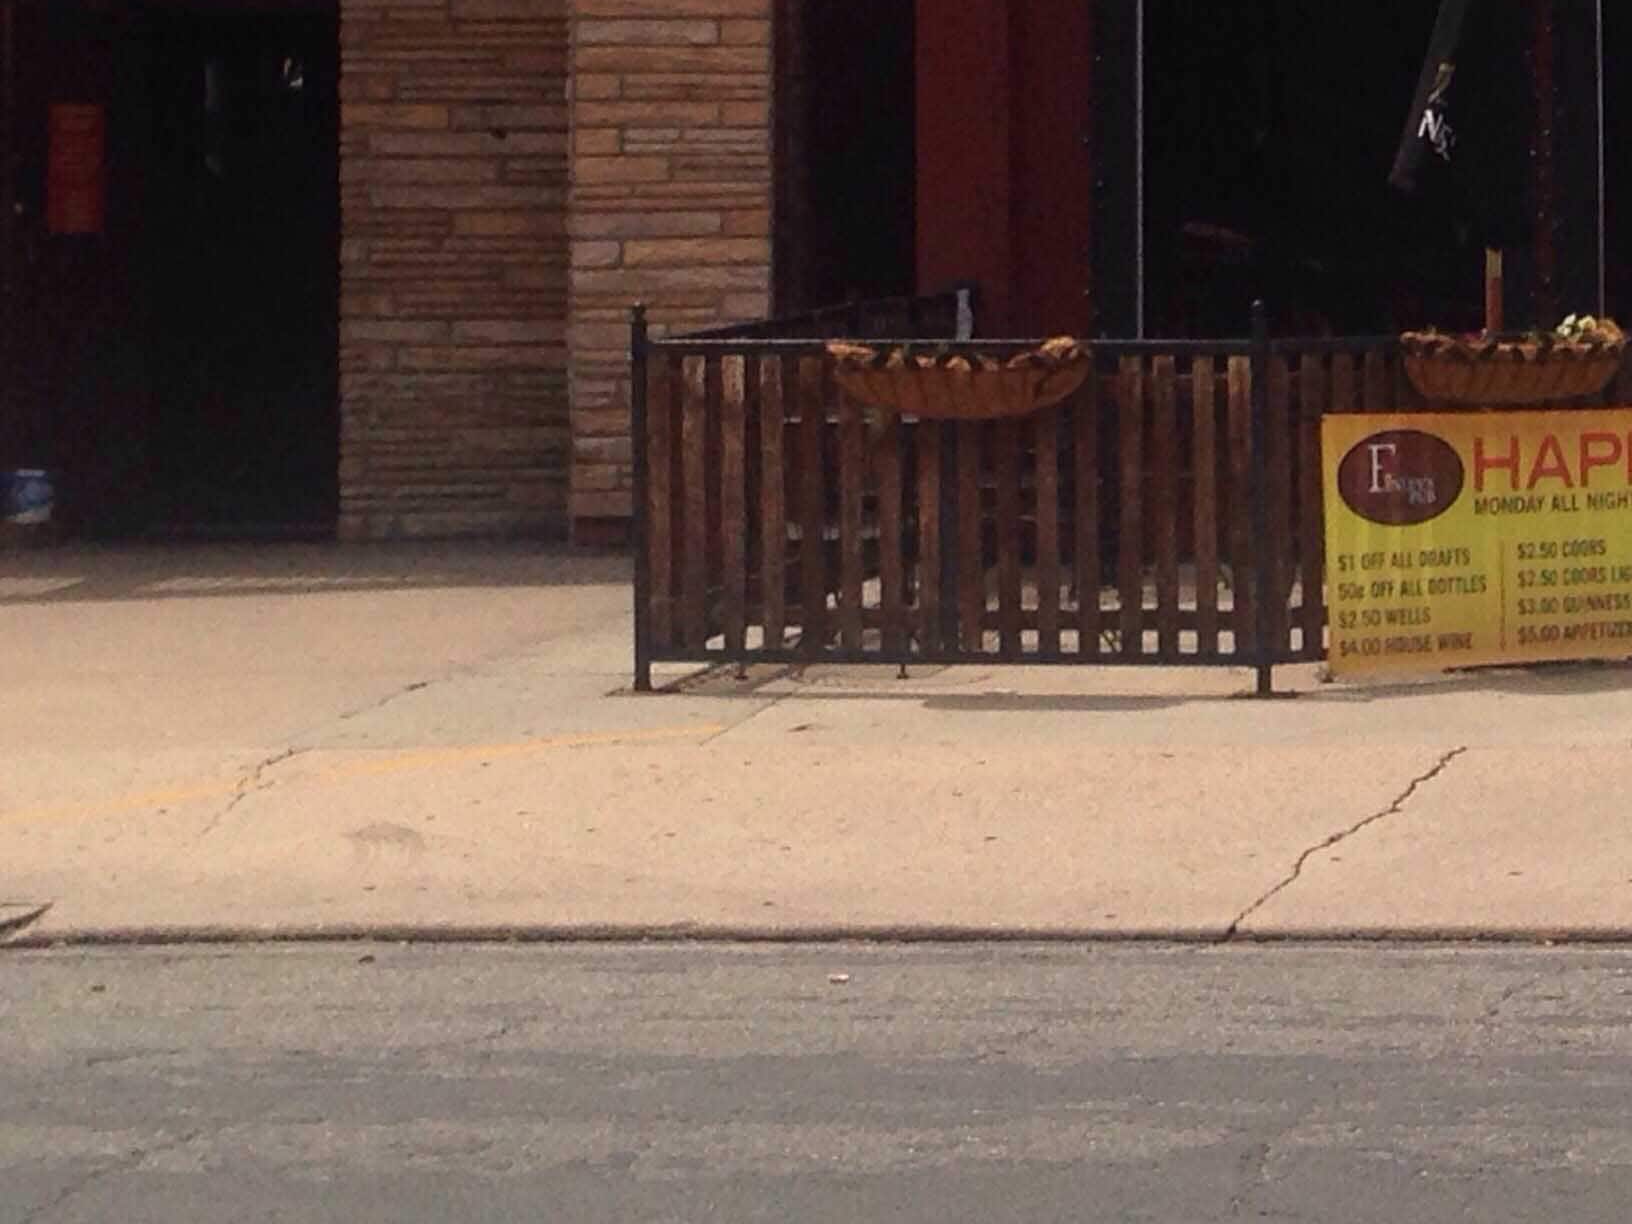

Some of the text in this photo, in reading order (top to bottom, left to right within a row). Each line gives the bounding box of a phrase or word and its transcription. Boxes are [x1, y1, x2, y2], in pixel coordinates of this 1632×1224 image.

[1474, 495, 1546, 515] MONDAY
[1551, 493, 1580, 513] ALL
[1361, 551, 1385, 570] OFF
[1392, 550, 1413, 569] ALL
[1419, 547, 1471, 568] DRAFTS
[1562, 538, 1607, 558] COORS
[1370, 579, 1394, 599] OFF
[1400, 578, 1423, 597] ALL
[1428, 574, 1488, 596] BOTTLES
[1562, 592, 1632, 613] GUINNESS
[1385, 606, 1432, 626] WELLS
